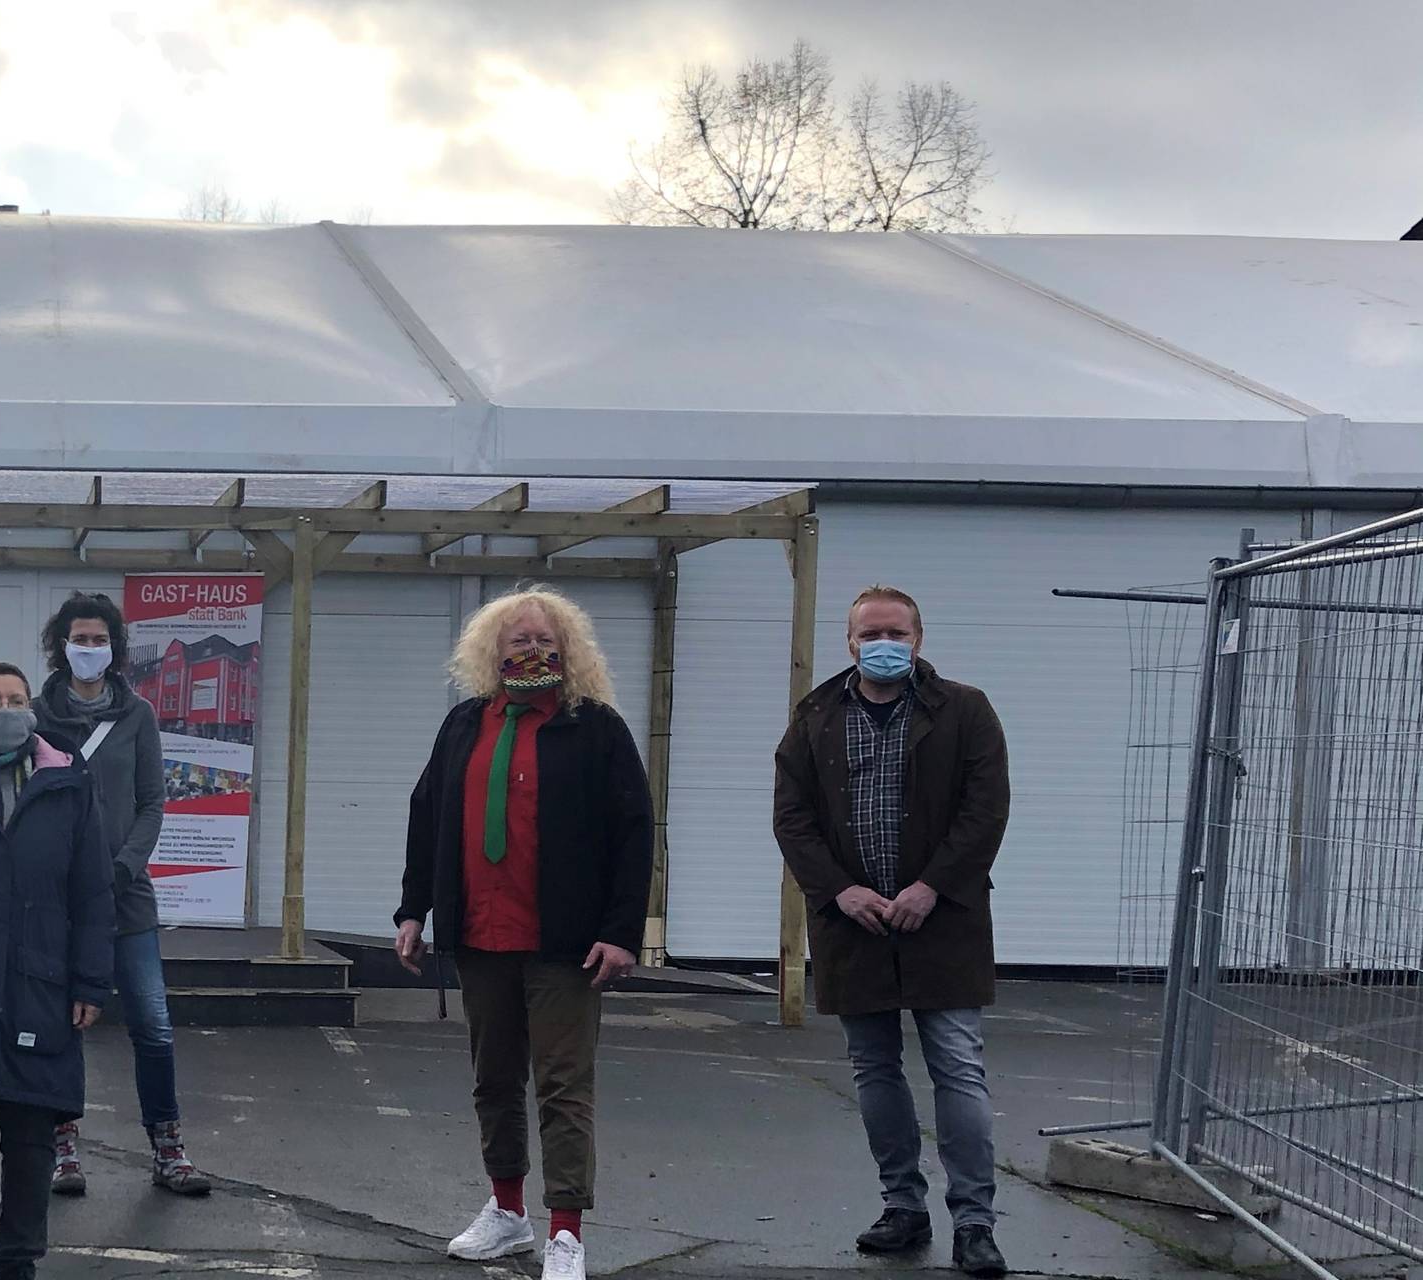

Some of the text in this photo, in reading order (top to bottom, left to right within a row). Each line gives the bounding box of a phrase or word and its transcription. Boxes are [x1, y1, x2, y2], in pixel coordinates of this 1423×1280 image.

[141, 584, 247, 603] GAST-HAUS
[189, 607, 247, 621] statt Bank
